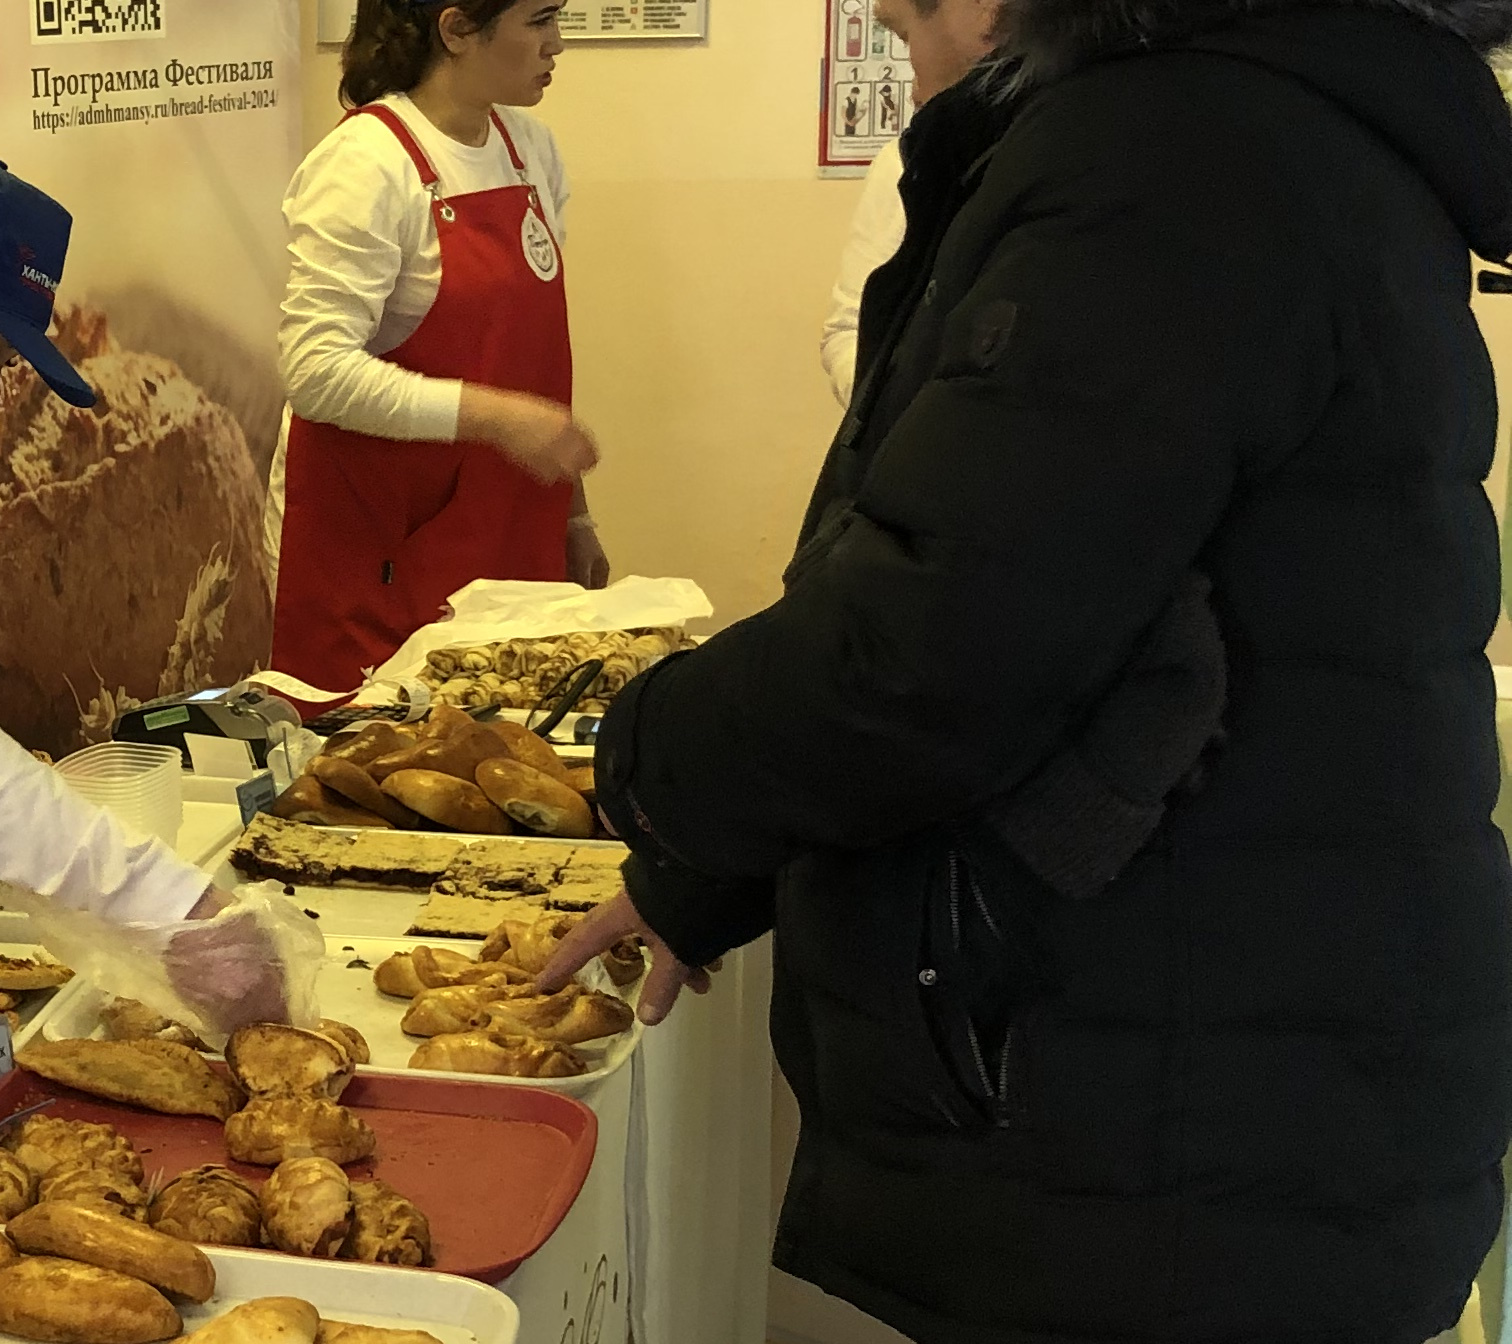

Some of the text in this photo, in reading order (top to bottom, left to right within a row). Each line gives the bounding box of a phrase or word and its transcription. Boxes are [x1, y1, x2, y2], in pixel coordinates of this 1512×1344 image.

[850, 67, 858, 81] 1
[883, 66, 893, 80] 2
[31, 59, 274, 106] Программа Фестиваля
